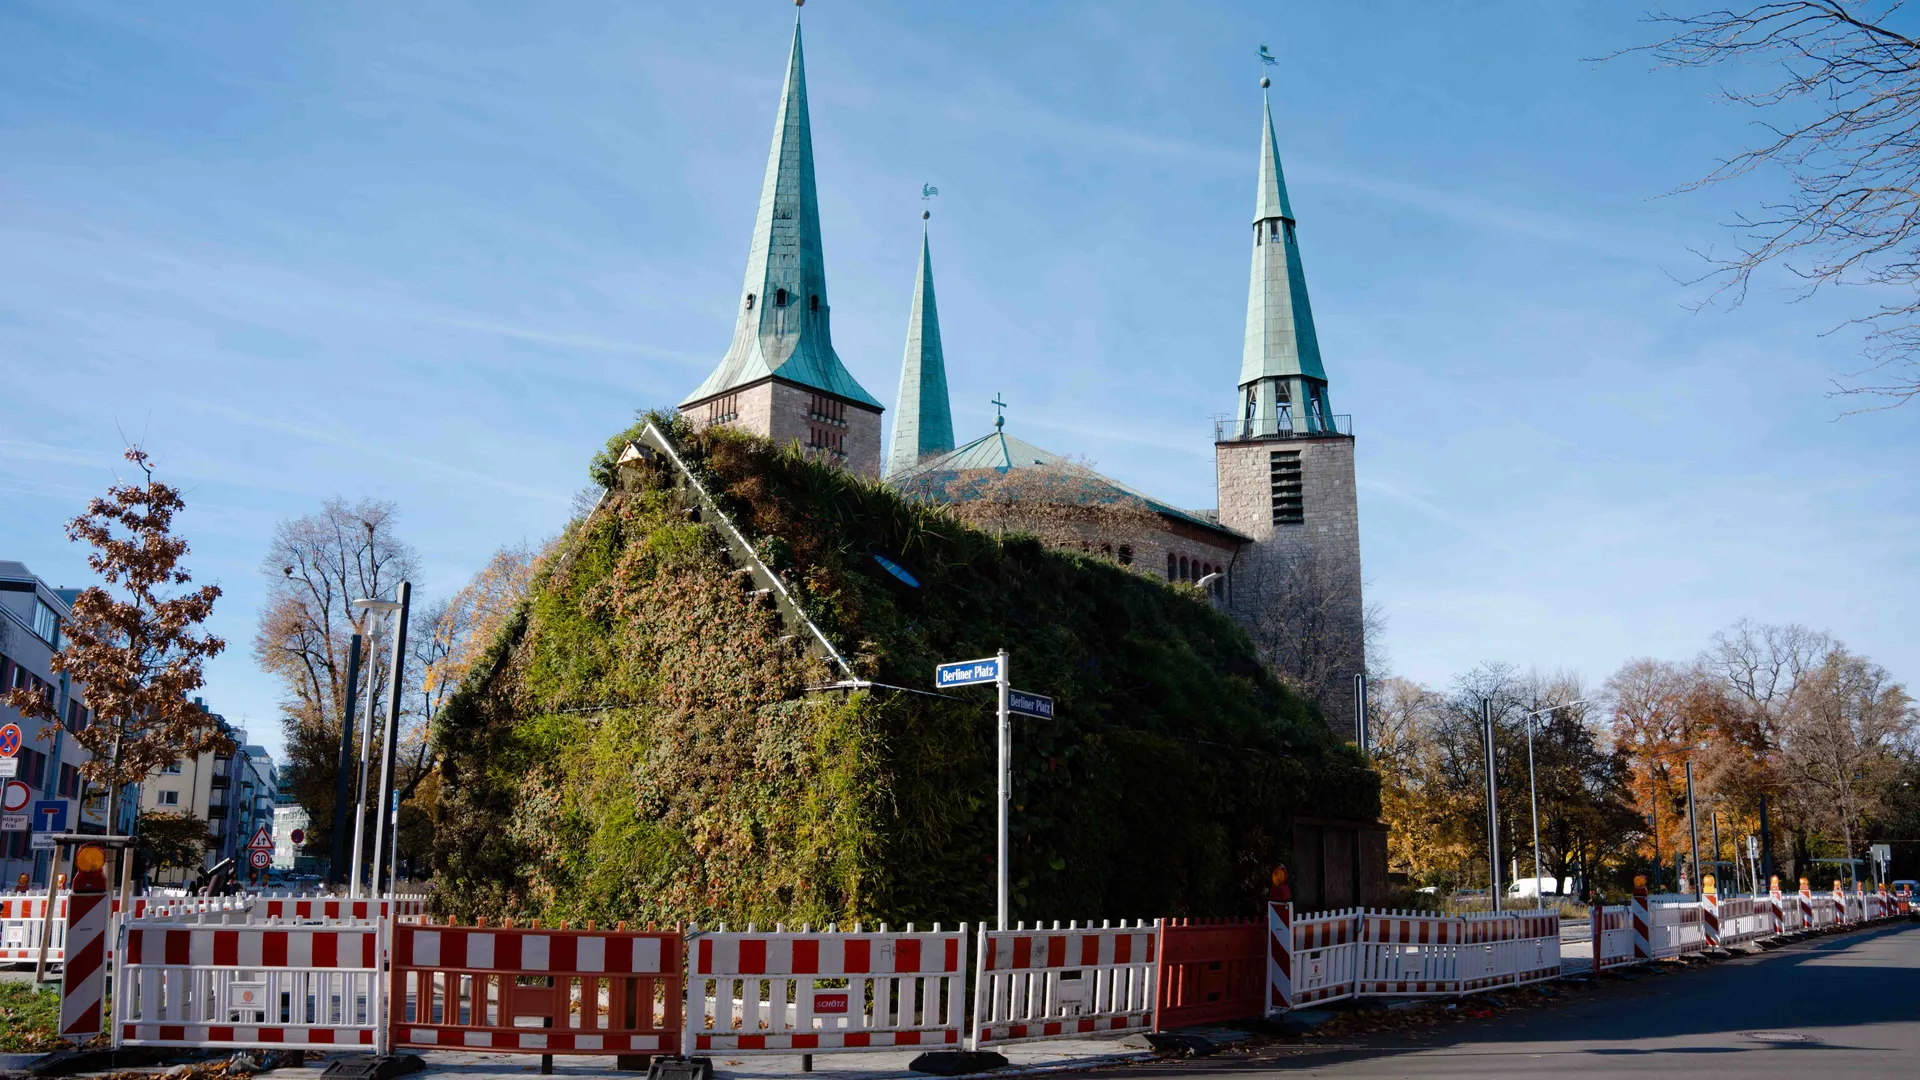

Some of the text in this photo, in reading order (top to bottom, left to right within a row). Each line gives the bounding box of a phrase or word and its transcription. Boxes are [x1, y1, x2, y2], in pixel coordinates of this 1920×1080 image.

[943, 665, 994, 682] Berliner Platz
[1010, 694, 1051, 714] Berliner Platz
[254, 854, 267, 864] 30
[816, 1000, 846, 1008] SCHÖTZ
